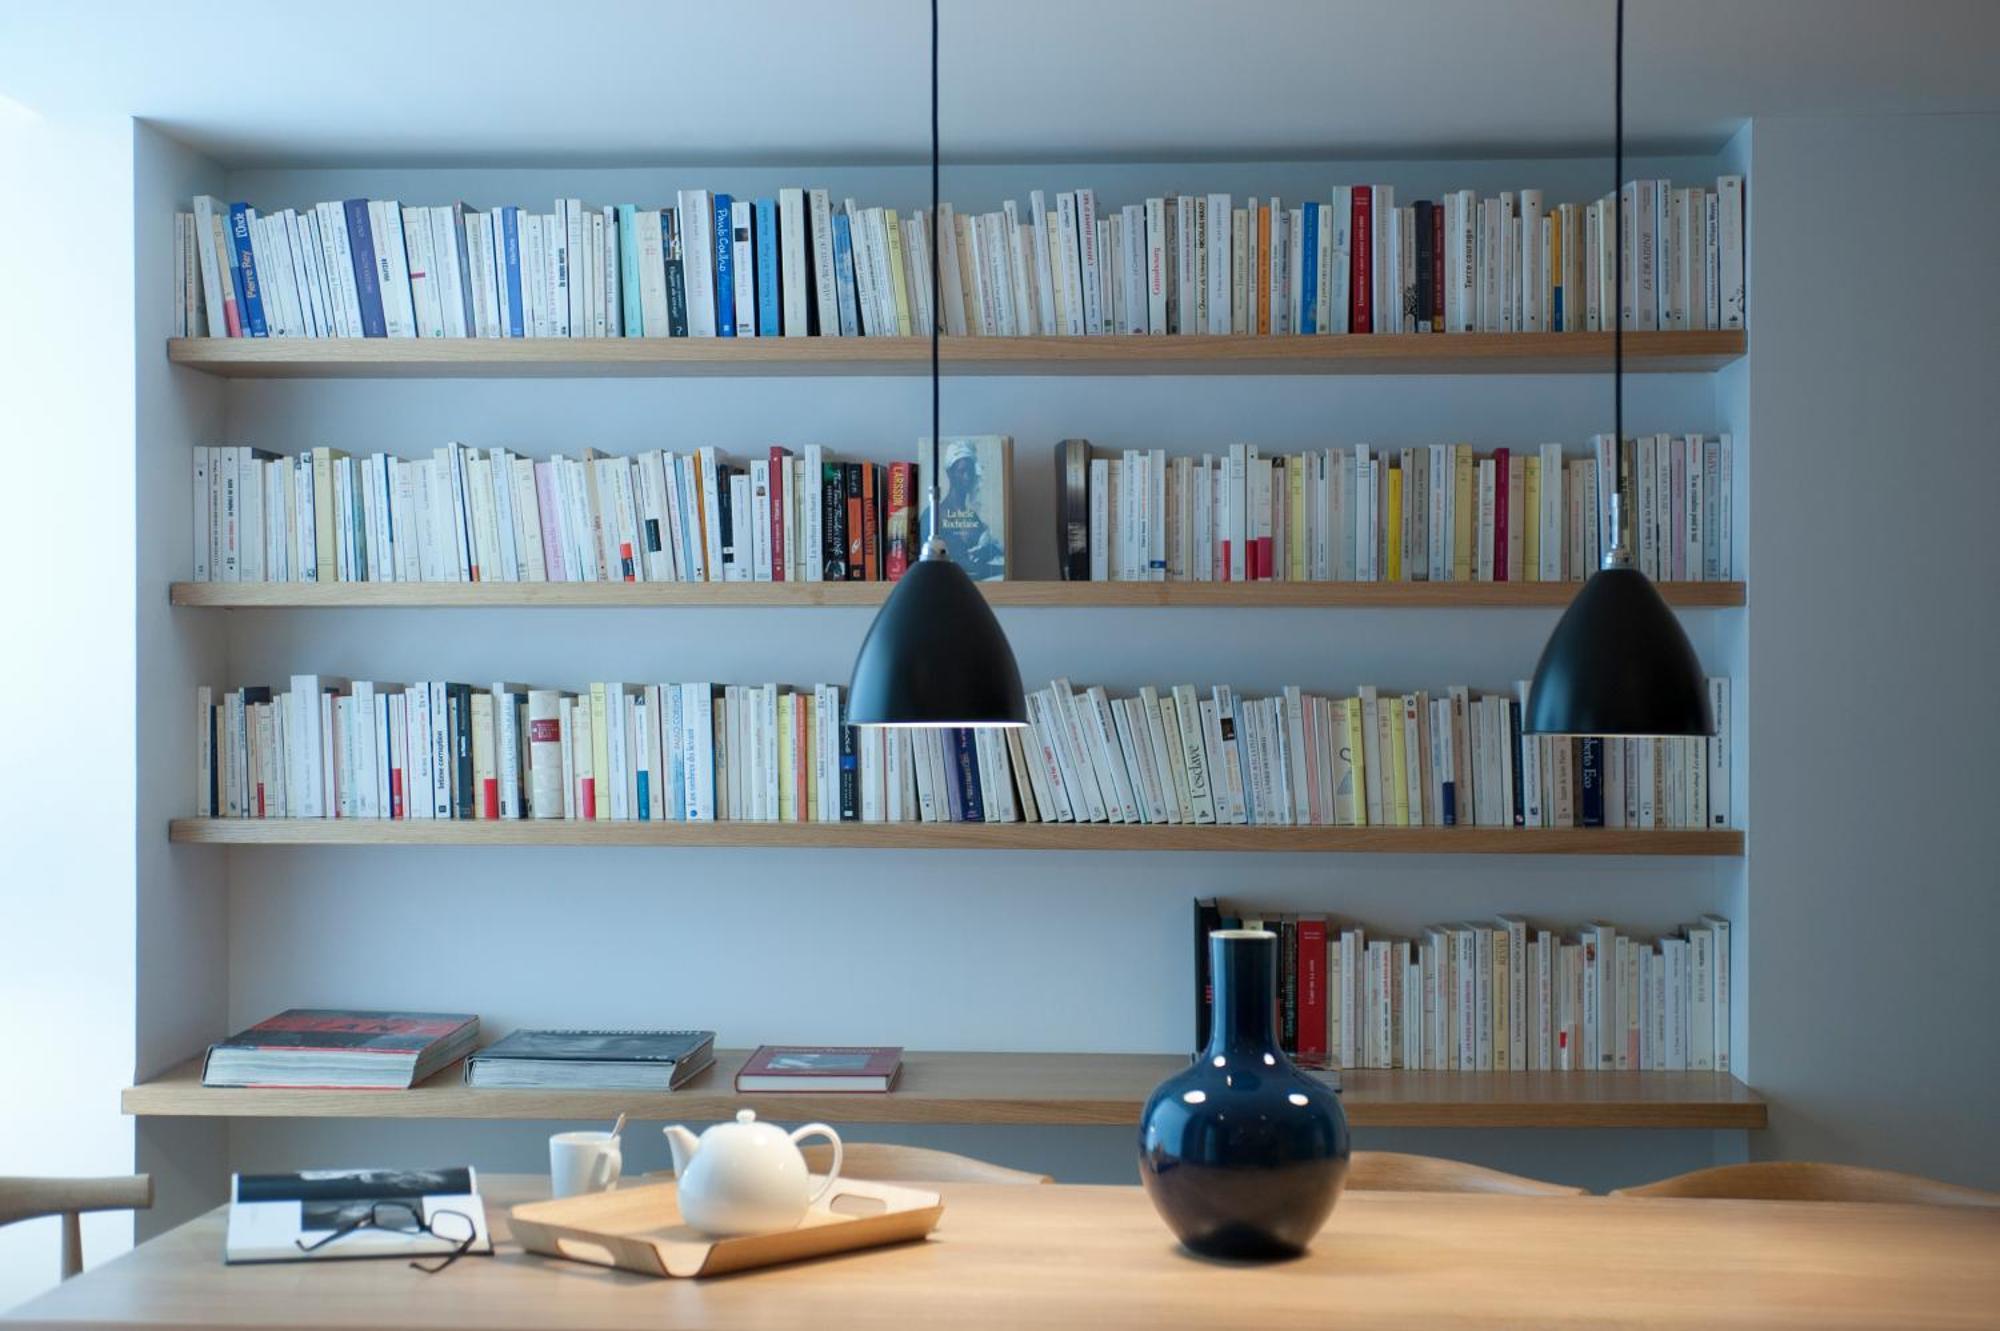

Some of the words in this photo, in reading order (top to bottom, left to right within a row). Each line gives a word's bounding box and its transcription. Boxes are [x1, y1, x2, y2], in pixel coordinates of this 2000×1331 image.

[717, 207, 728, 236] Paulo
[719, 237, 729, 272] Coelho
[1465, 229, 1473, 263] courage
[245, 269, 257, 299] Pierre
[1152, 247, 1161, 296] Gainsbourg
[1464, 263, 1472, 288] Terre
[893, 465, 905, 506] LARSSON
[947, 509, 957, 518] La
[1188, 743, 1207, 799] L'esclave
[1584, 768, 1597, 789] Eco
